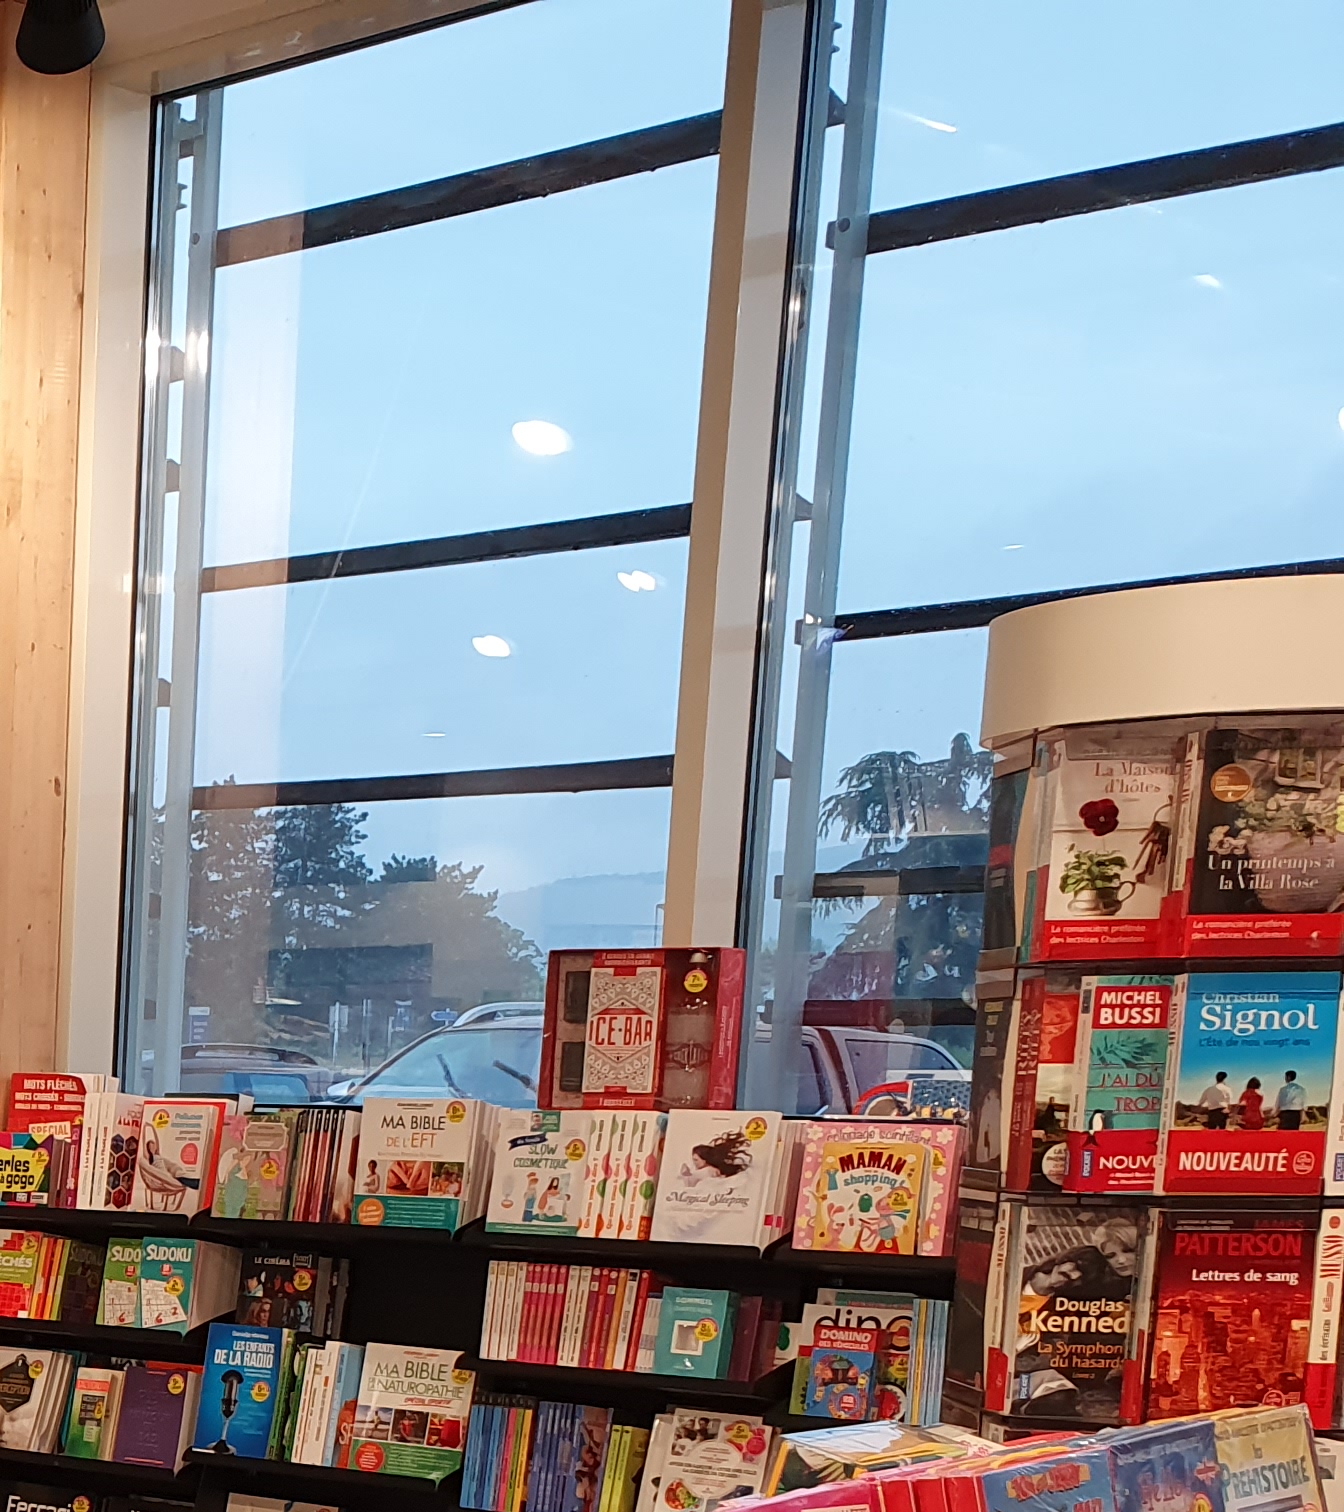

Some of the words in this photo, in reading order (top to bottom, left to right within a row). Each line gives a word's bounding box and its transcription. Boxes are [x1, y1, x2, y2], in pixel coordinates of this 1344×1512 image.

[1105, 778, 1161, 793] d'hôtes
[1207, 855, 1231, 870] Un
[1236, 855, 1319, 878] printemps
[1219, 874, 1234, 890] la
[1236, 873, 1274, 891] Villa
[1280, 874, 1319, 889] Rose
[1100, 991, 1162, 1006] MICHEL
[1099, 1007, 1161, 1025] BUSSI
[1199, 1004, 1319, 1037] Signol
[1101, 1072, 1131, 1088] J'AI
[380, 1116, 408, 1131] MA
[410, 1115, 446, 1132] BIBLE
[838, 1151, 907, 1175] MAMAN
[1179, 1148, 1289, 1172] NOUVEAUTÉ
[0, 1174, 5, 1185] à
[6, 1173, 34, 1189] gogo
[843, 1172, 897, 1189] shopping
[1175, 1232, 1302, 1256] PATTERSON
[146, 1244, 192, 1263] SUDOKU
[1319, 1234, 1344, 1280] MUSSO
[1191, 1269, 1240, 1283] Lettres
[1244, 1269, 1262, 1282] de
[1266, 1270, 1299, 1286] sang
[1055, 1298, 1124, 1316] Douglas
[819, 1327, 870, 1343] DOMINO
[1037, 1342, 1053, 1354] La
[243, 1351, 274, 1368] RADIO
